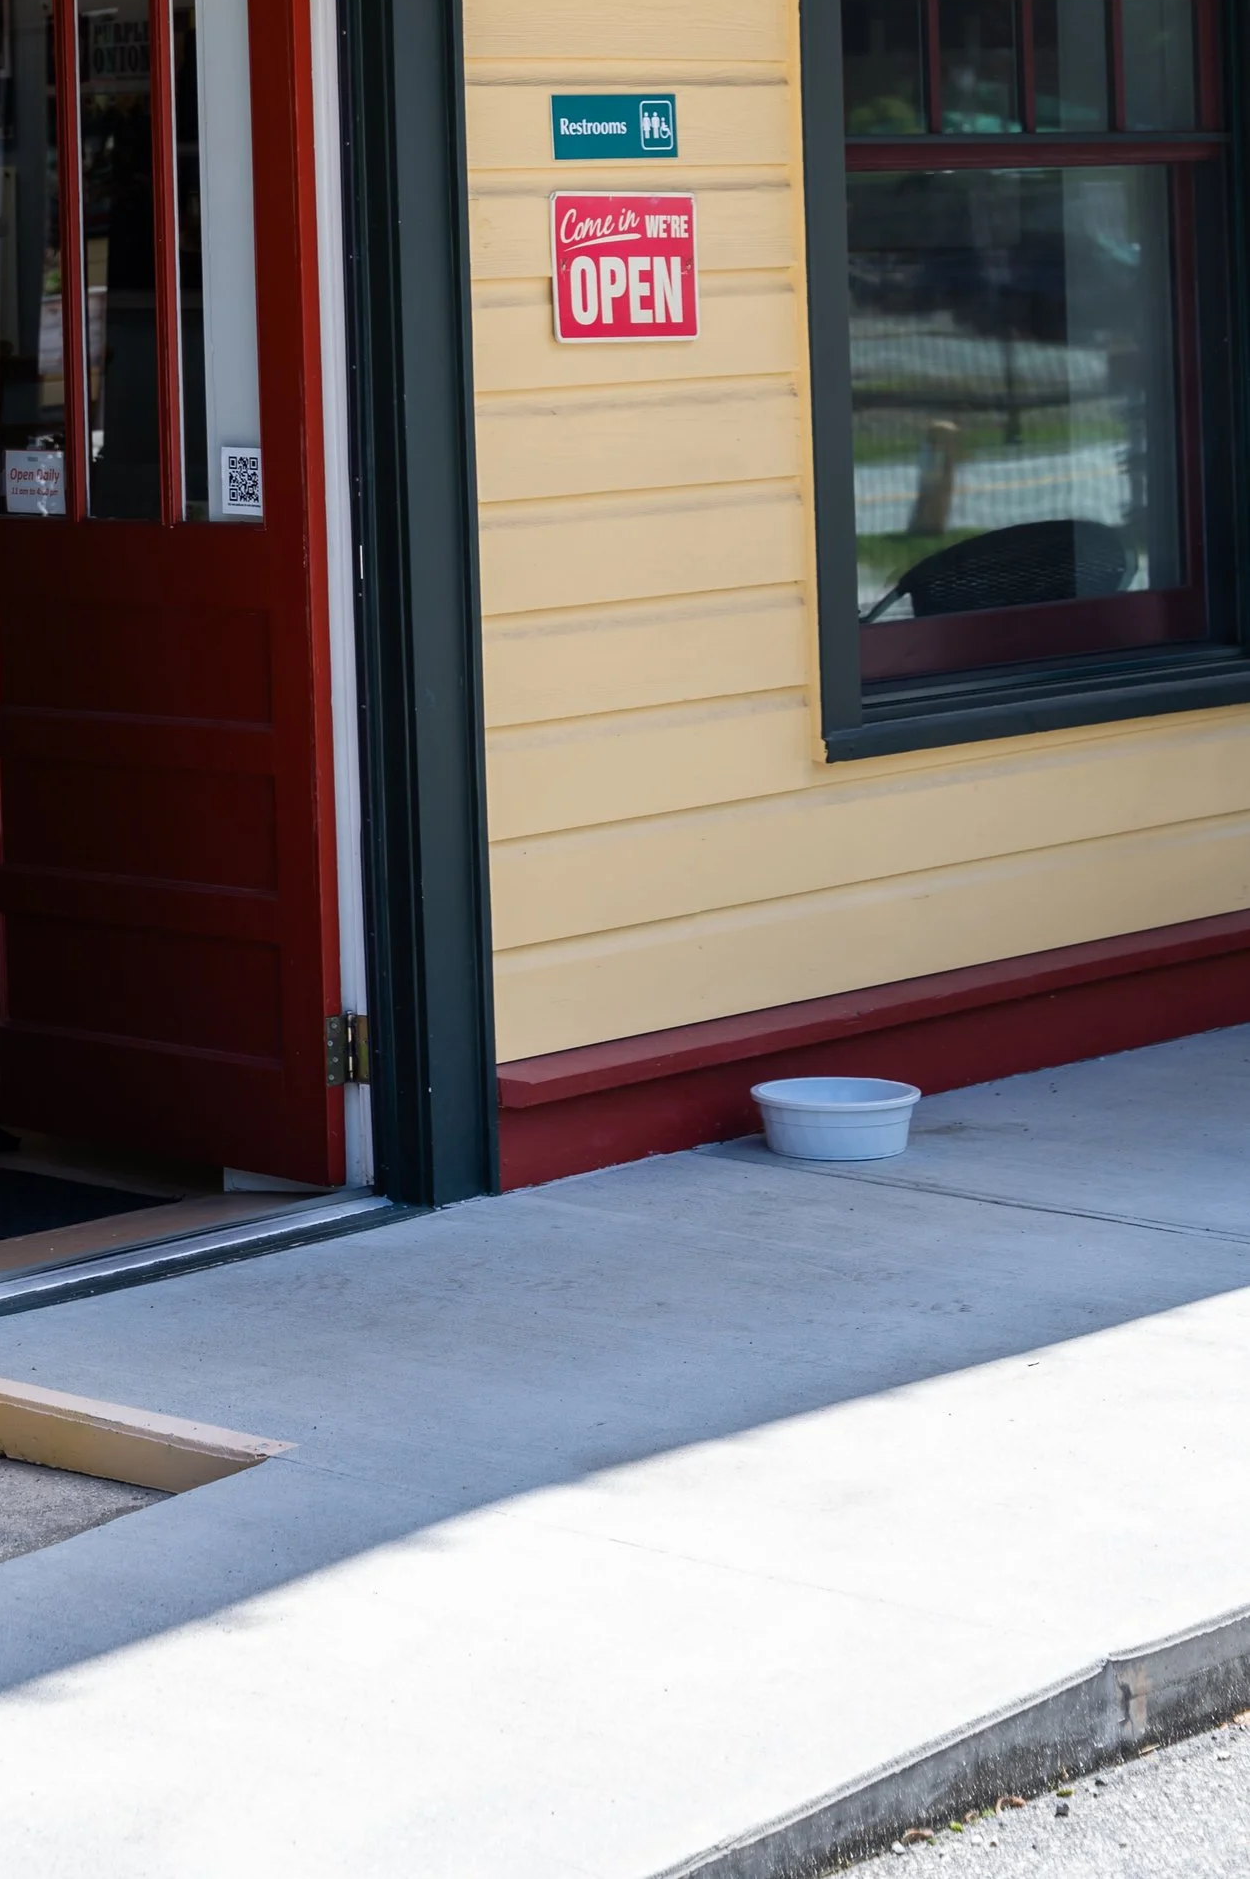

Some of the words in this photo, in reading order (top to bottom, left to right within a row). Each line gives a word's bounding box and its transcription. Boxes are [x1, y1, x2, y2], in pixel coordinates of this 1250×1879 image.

[559, 117, 628, 135] Restrooms
[559, 208, 616, 244] Come
[617, 208, 640, 232] in
[644, 214, 690, 238] WE'RE
[570, 255, 684, 326] OPEN
[9, 467, 34, 482] Open
[36, 468, 60, 484] Daily
